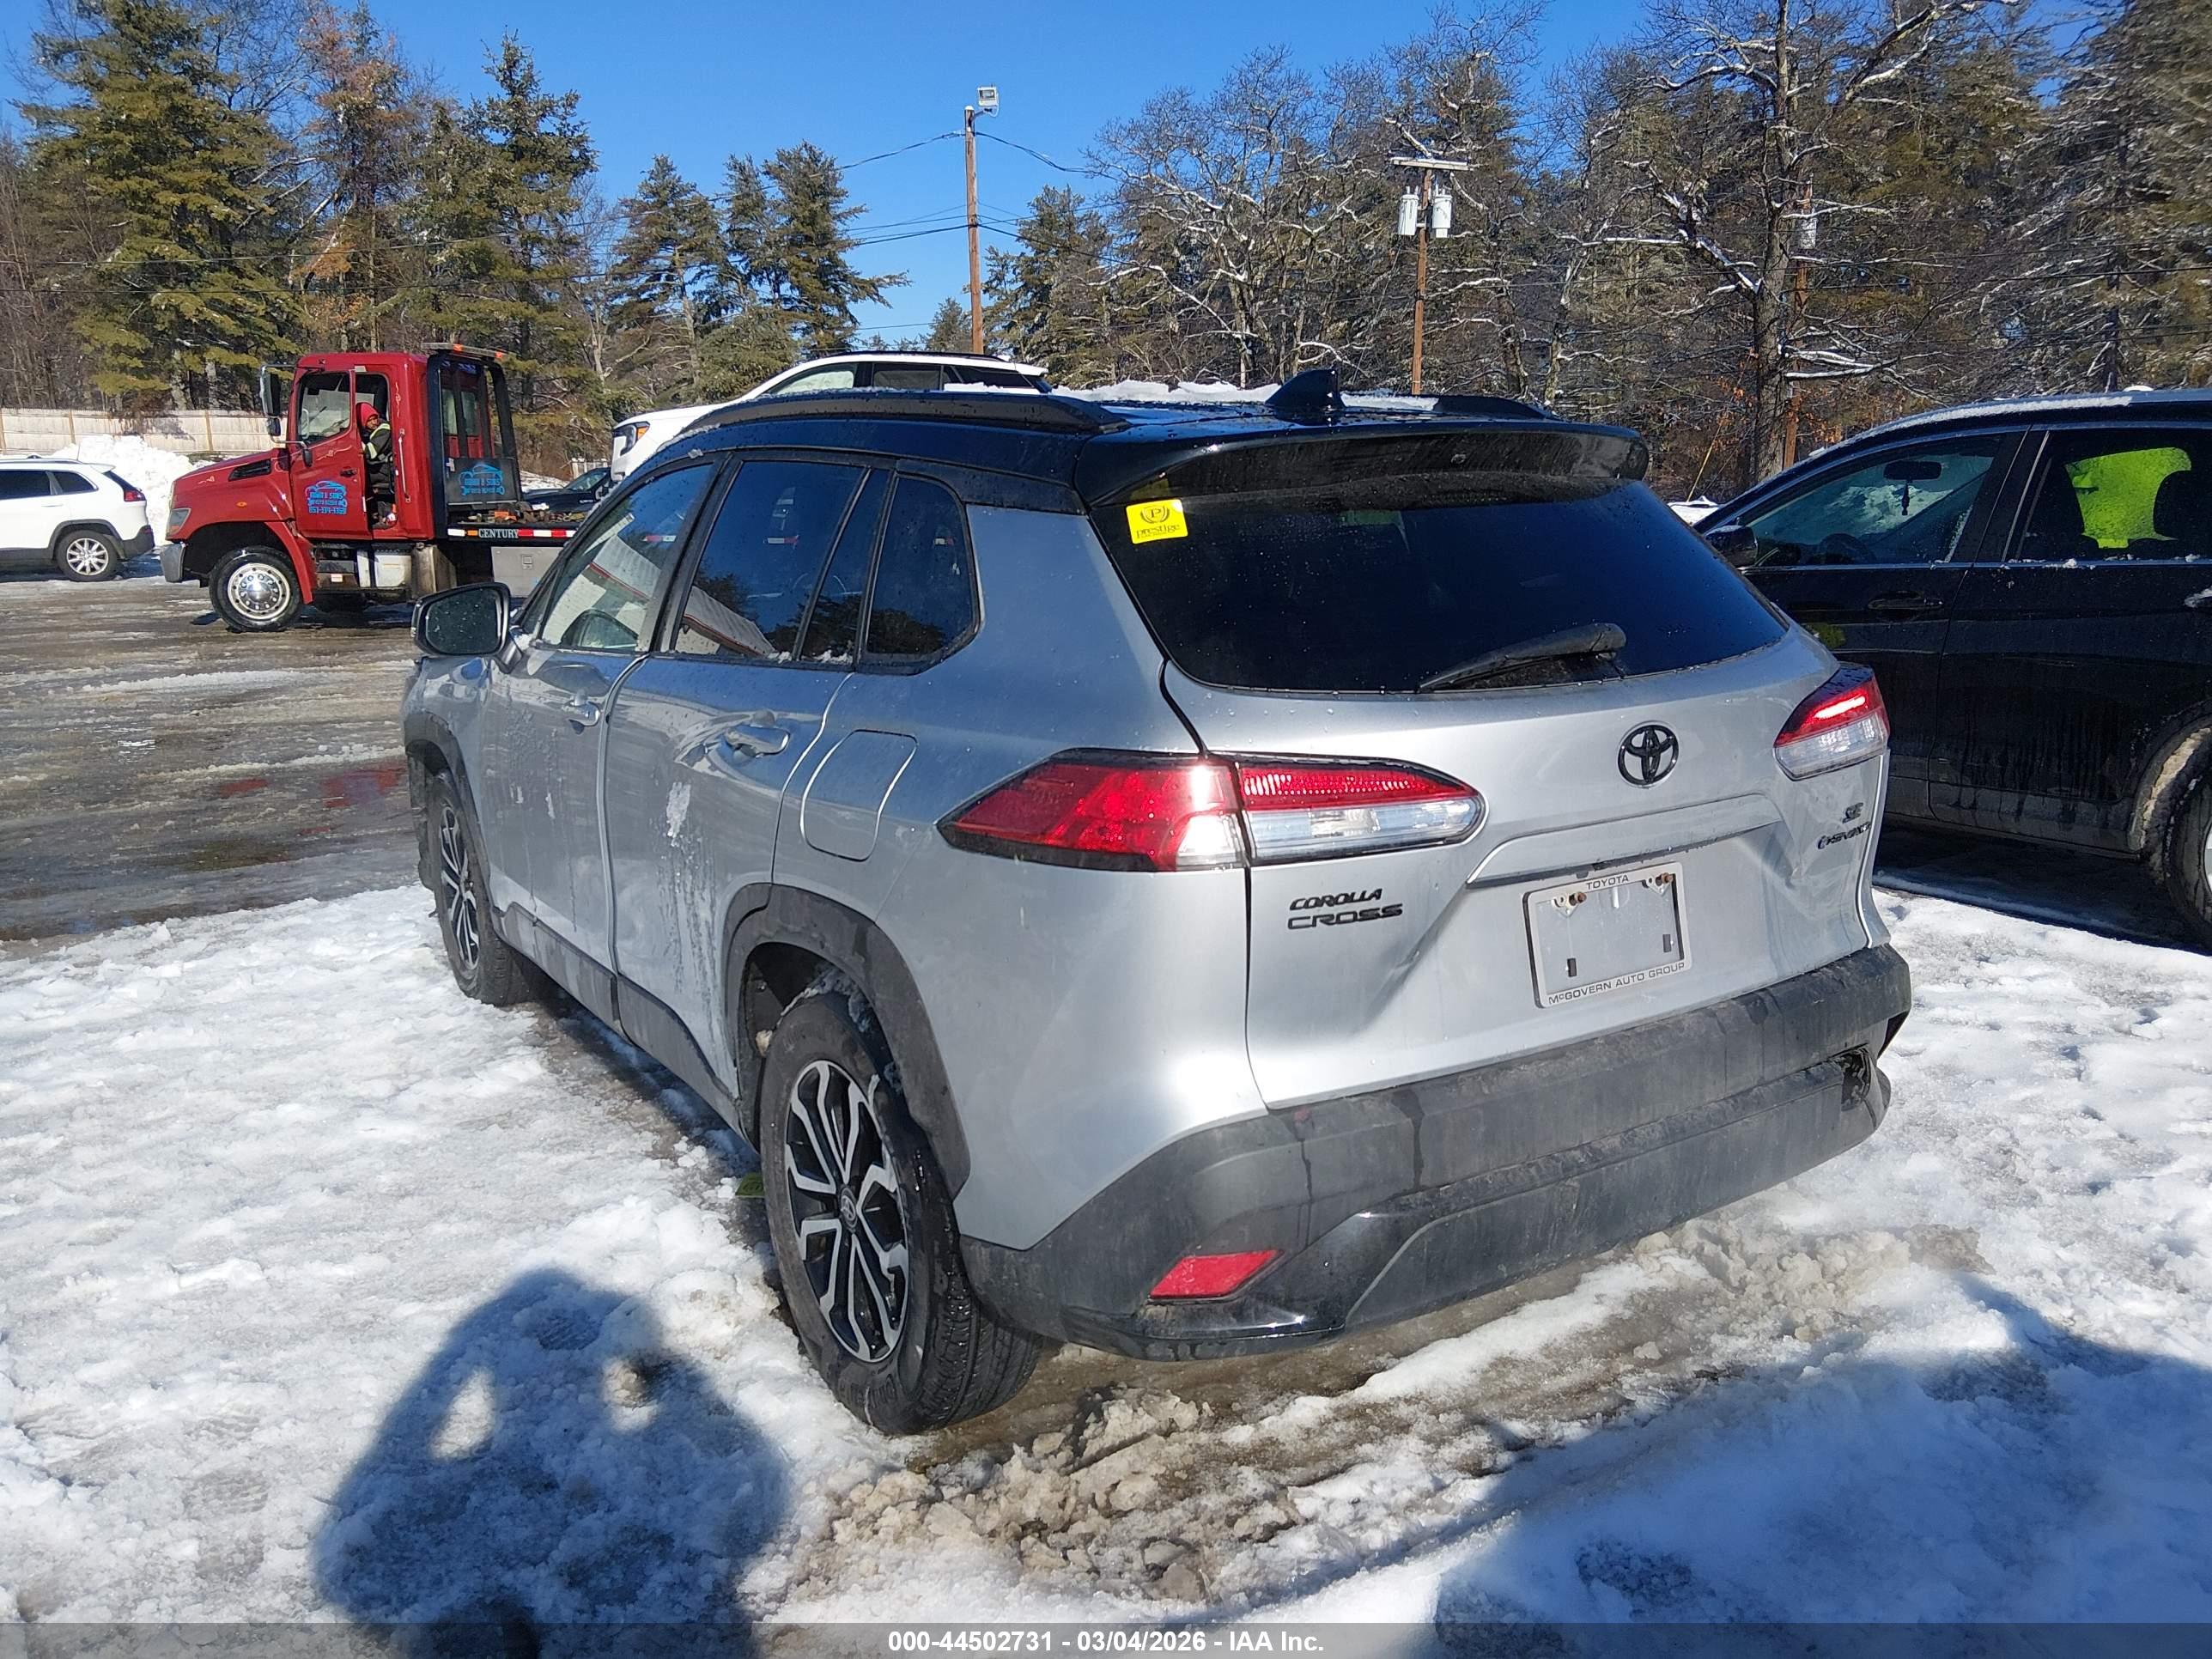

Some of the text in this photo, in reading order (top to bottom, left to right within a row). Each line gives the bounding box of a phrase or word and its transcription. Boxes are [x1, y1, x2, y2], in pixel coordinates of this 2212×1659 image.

[478, 528, 519, 538] CENTURY
[1136, 525, 1181, 538] prestige
[1587, 874, 1629, 890] TOYOTA
[1289, 888, 1382, 910] COROLLA
[1287, 903, 1403, 929] CROSS
[1548, 962, 1685, 1005] McGOVERN AUTO GROUP
